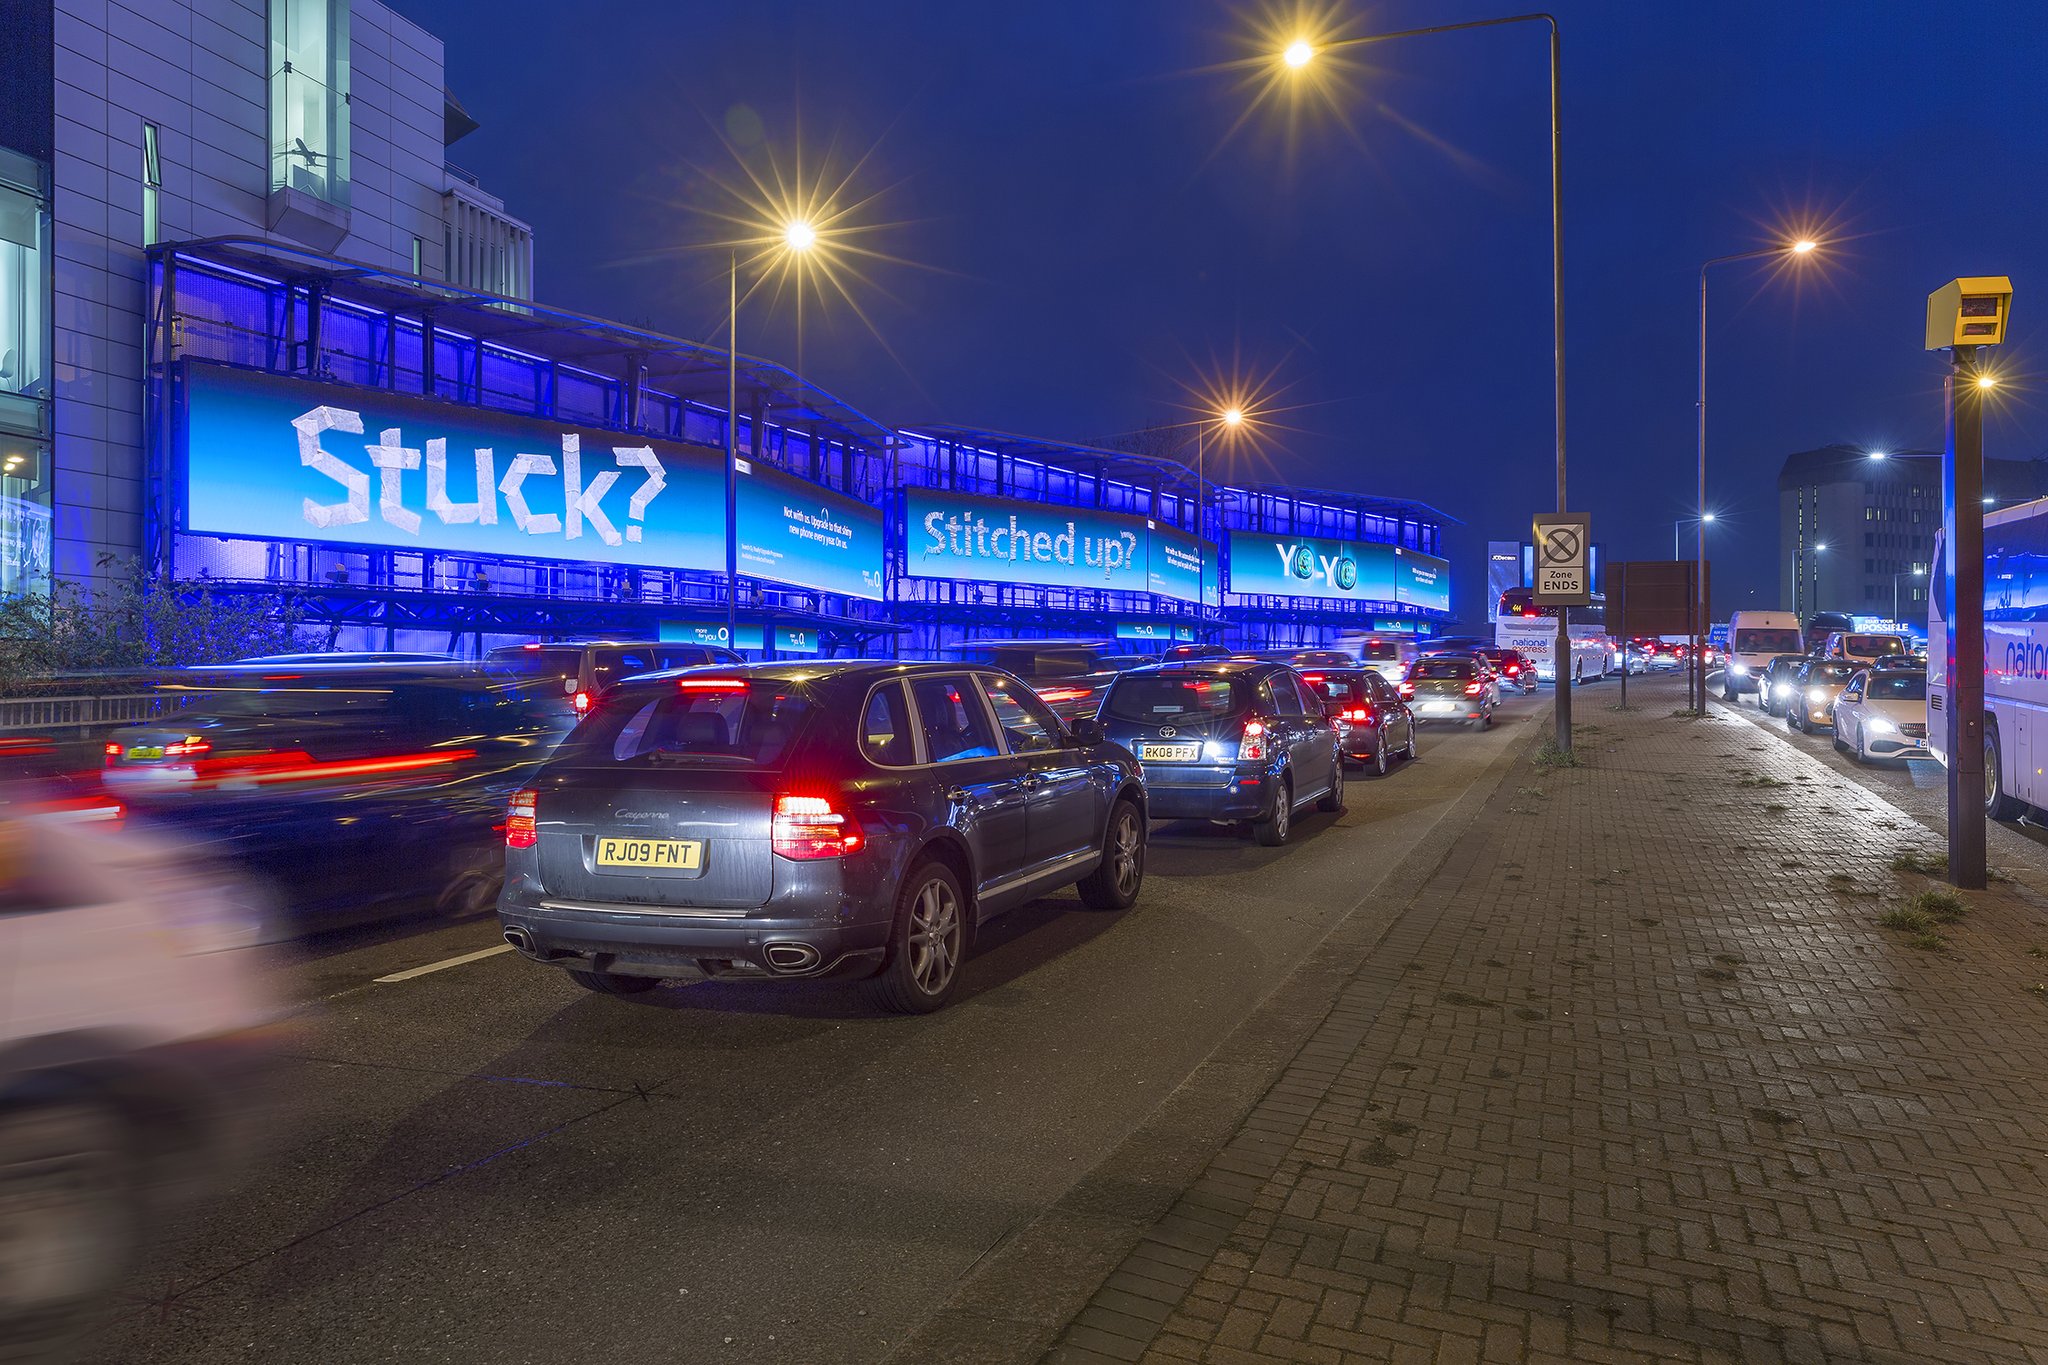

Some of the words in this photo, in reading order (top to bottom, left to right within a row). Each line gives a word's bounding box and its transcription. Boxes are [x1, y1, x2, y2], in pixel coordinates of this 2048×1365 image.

[291, 405, 667, 546] Stuck?
[810, 515, 829, 530] Upgrade
[924, 511, 1075, 566] Stitched
[1084, 530, 1137, 580] up?
[1543, 580, 1579, 590] ENDS
[704, 634, 716, 643] you
[1512, 638, 1548, 646] national
[1512, 646, 1548, 654] express
[1145, 747, 1173, 757] RK08
[1175, 747, 1196, 757] PFX
[614, 808, 670, 822] Cayenne
[605, 842, 650, 862] RJ09
[655, 843, 692, 863] FNT
